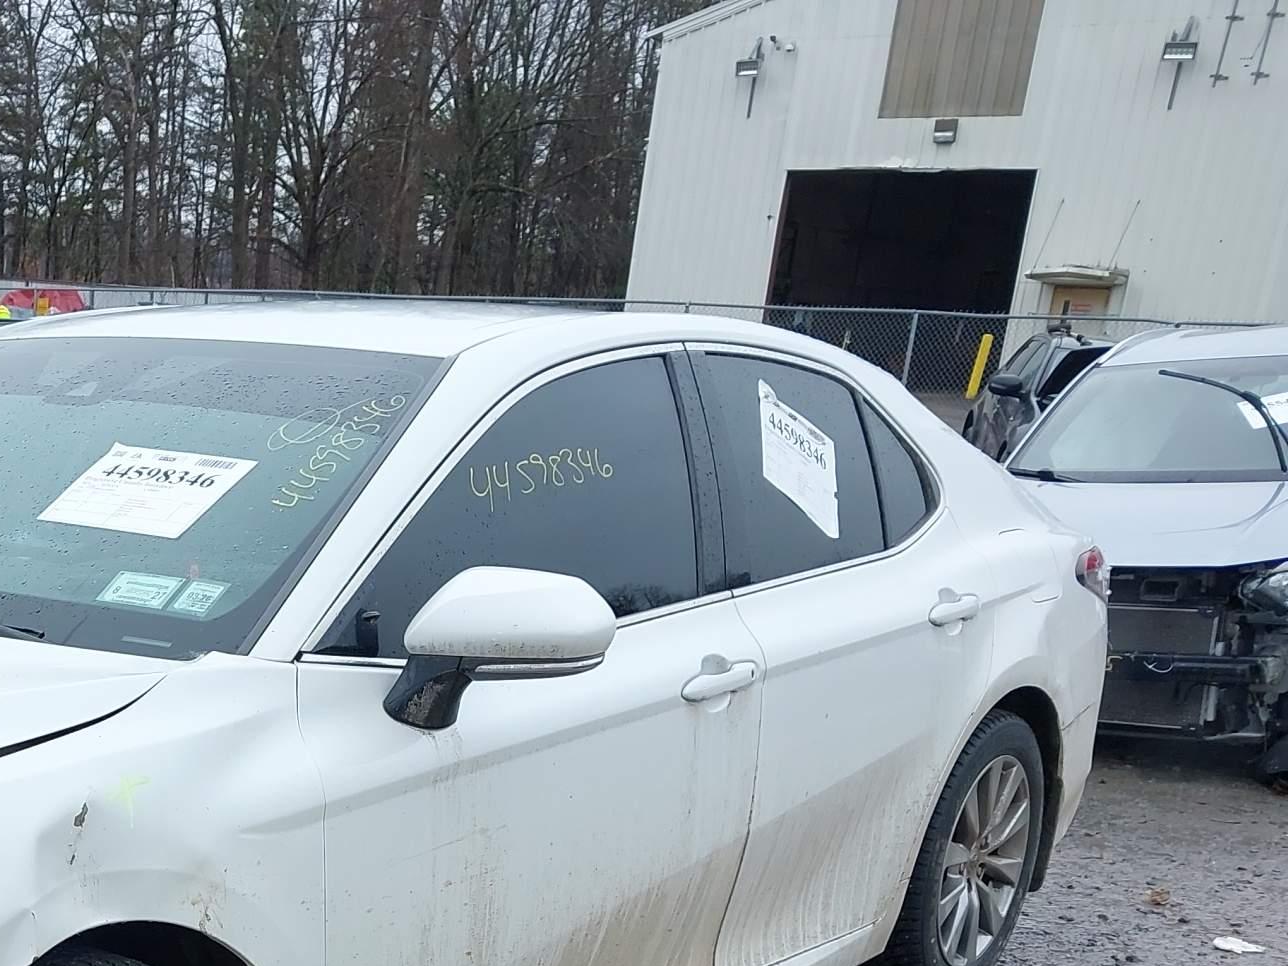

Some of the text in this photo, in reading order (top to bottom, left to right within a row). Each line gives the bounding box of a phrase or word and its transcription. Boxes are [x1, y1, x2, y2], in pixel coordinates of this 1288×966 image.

[271, 394, 407, 511] 44598346
[767, 411, 827, 470] 44598346
[101, 463, 221, 489] 44598346
[469, 448, 614, 512] 44598346
